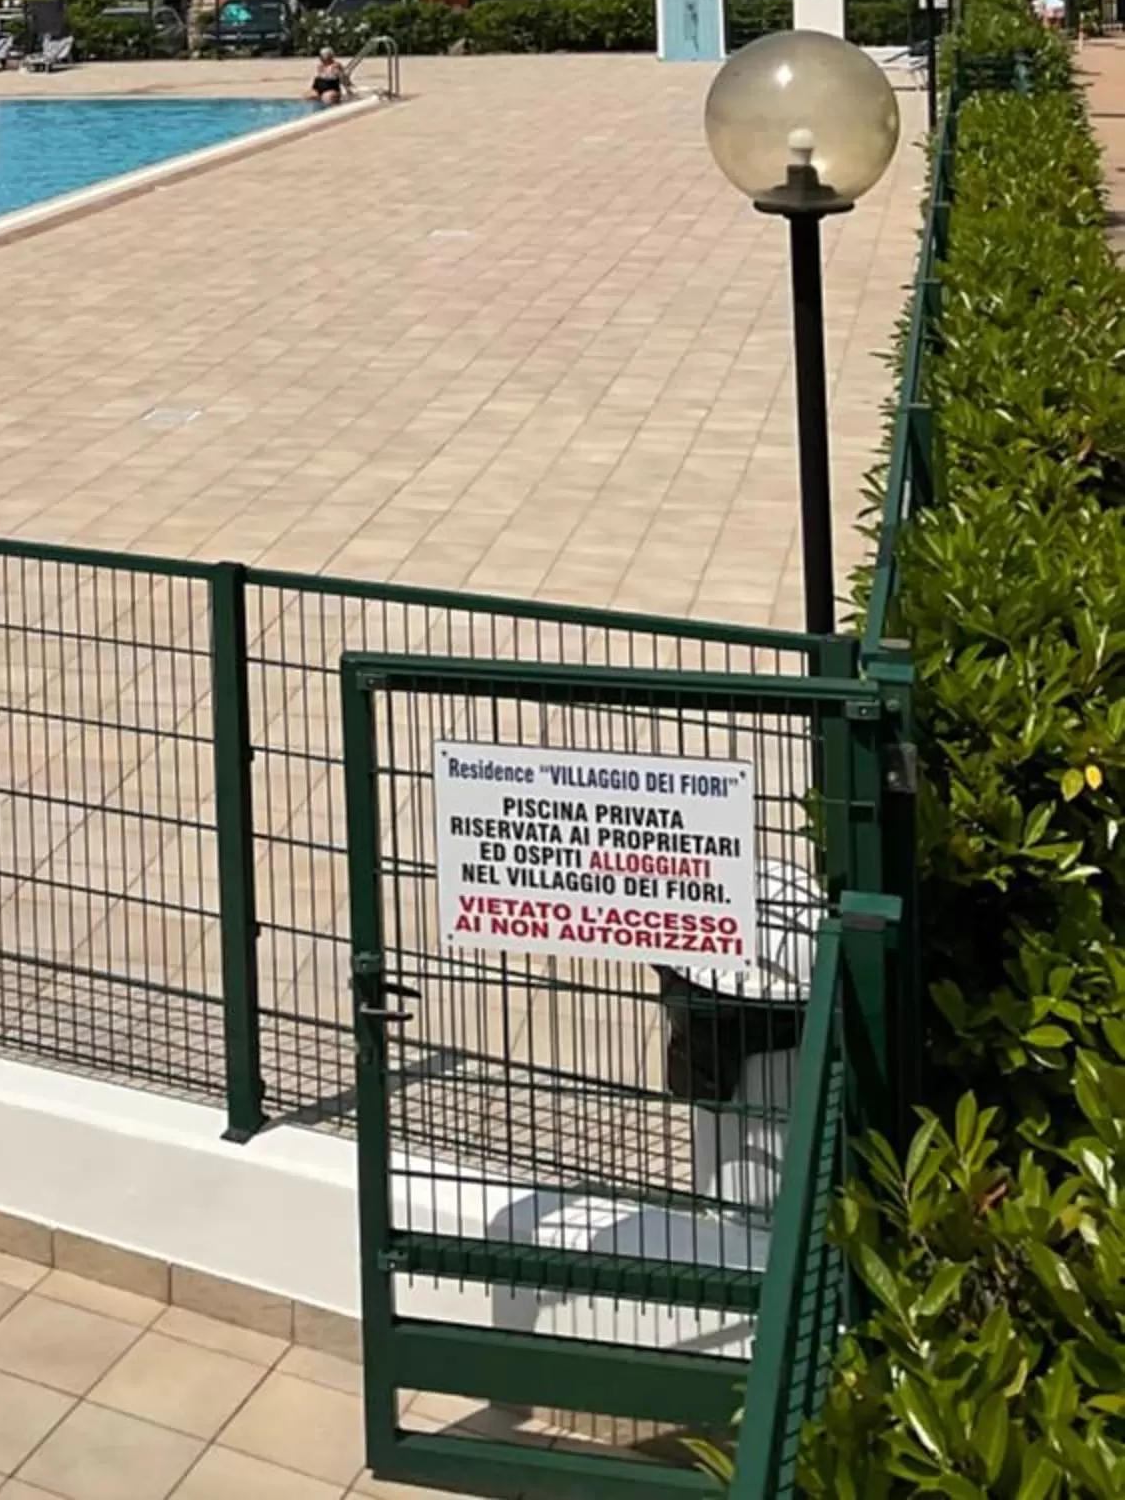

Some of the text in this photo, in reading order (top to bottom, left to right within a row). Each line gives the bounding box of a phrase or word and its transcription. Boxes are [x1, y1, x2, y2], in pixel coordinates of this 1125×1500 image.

[448, 758, 534, 783] Residence
[646, 774, 675, 794] DEI
[503, 797, 684, 829] PISCINA PRIVATA
[451, 817, 740, 857] RISERVATA AI PROPRIETARI
[480, 842, 711, 878] ED OSPITI ALLOGGIATI
[462, 864, 731, 904] NEL VILLAGGIO DEI FIORI.
[459, 896, 737, 935] VIETATO L'ACCESSO
[455, 915, 743, 956] AI NON AUTORIZZATI
